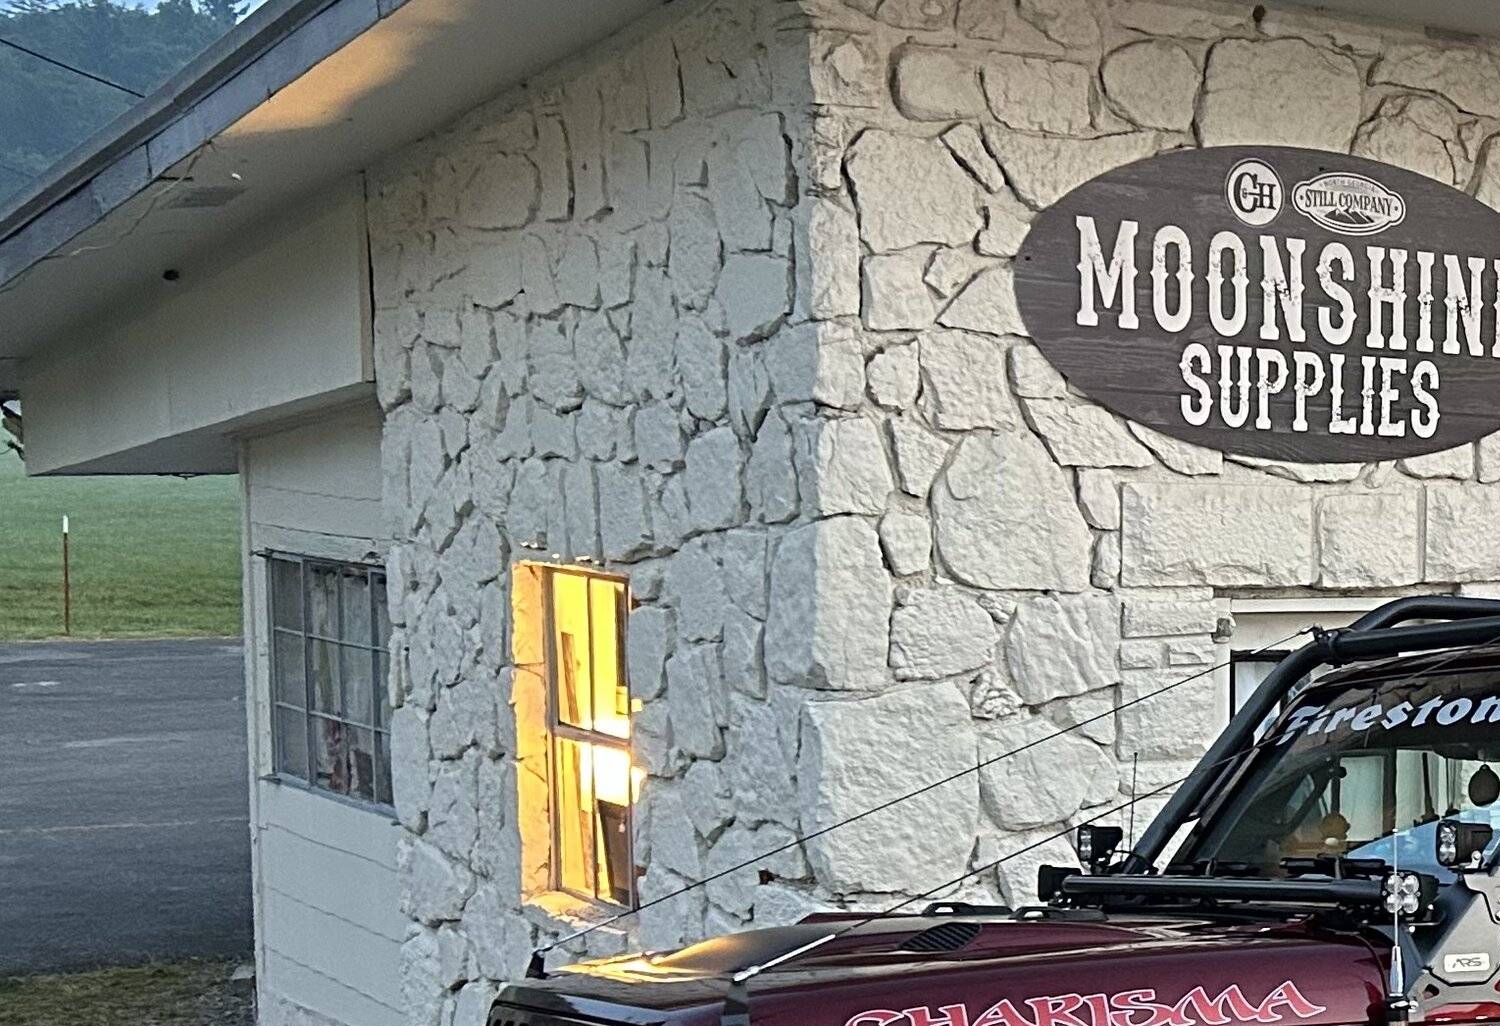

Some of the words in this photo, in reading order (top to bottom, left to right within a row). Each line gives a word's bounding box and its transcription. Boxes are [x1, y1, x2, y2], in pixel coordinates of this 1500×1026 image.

[1305, 188, 1337, 208] STILL
[1339, 192, 1393, 217] COMPANY
[1178, 342, 1441, 439] SUPPLIES
